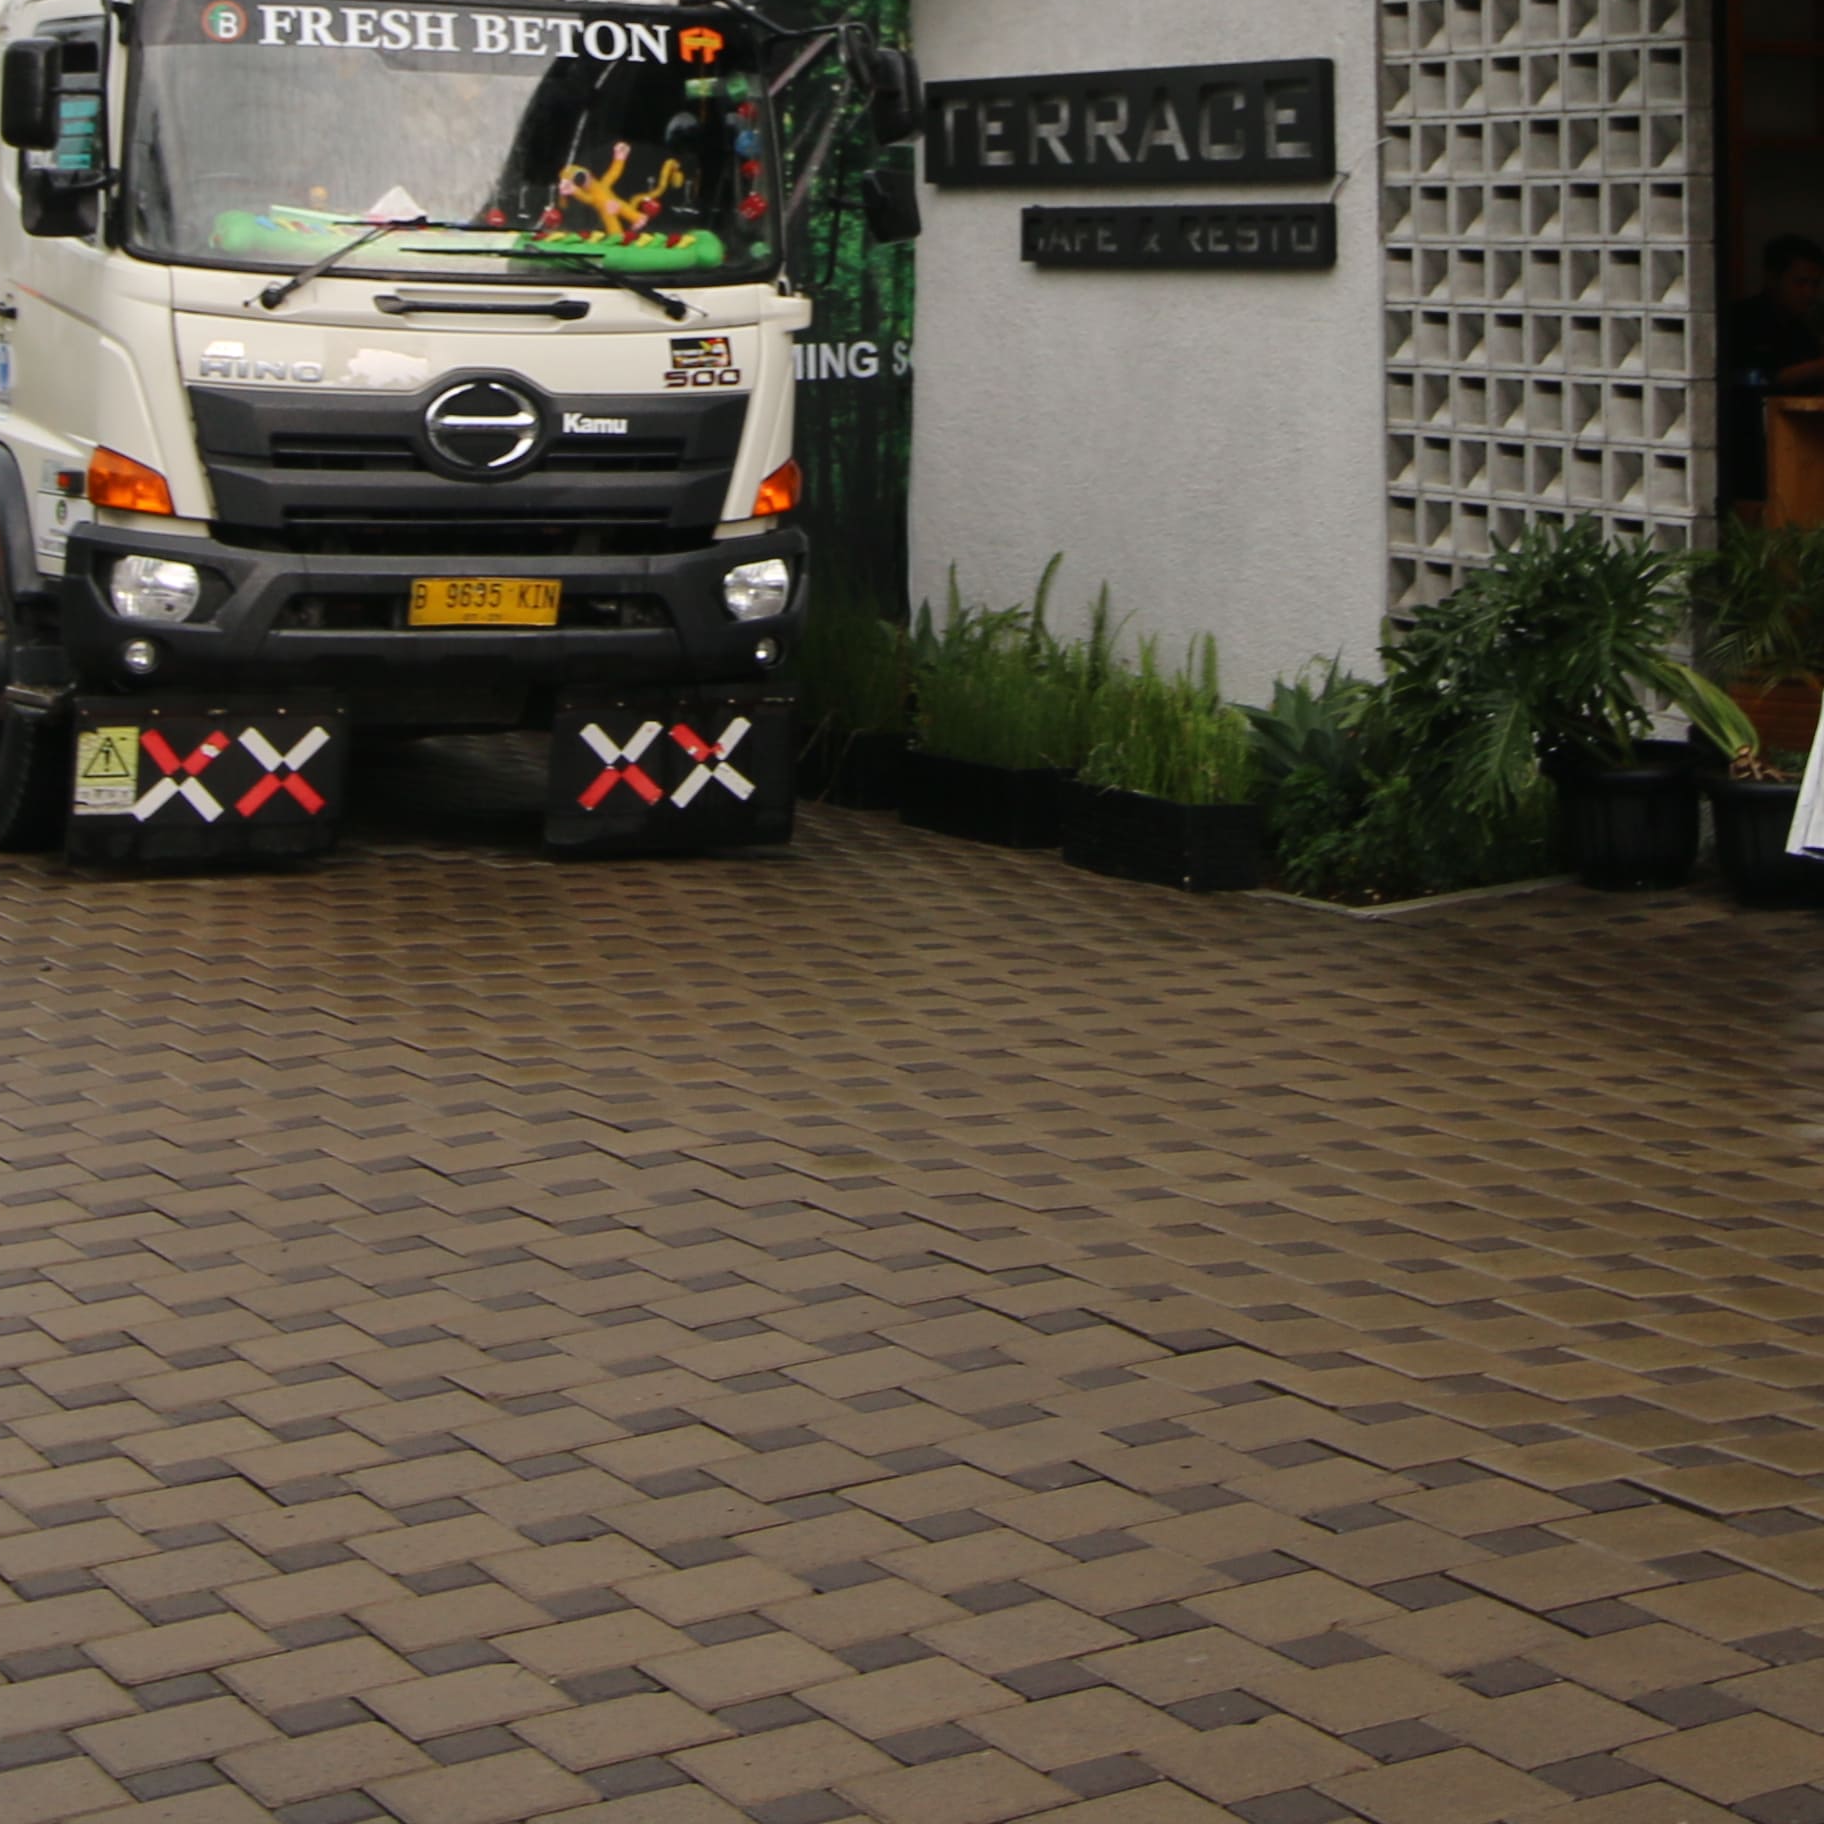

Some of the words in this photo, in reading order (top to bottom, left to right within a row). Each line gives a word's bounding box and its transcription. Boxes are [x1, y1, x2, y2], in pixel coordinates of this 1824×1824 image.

[258, 5, 461, 53] FRESH
[471, 13, 670, 64] BETON
[933, 77, 1313, 167] TERRACE
[1026, 214, 1119, 253] CAFE
[1179, 213, 1318, 252] RESTO
[199, 358, 324, 383] HINO
[664, 368, 741, 388] 500
[562, 412, 628, 435] Kamu
[414, 583, 428, 610] B
